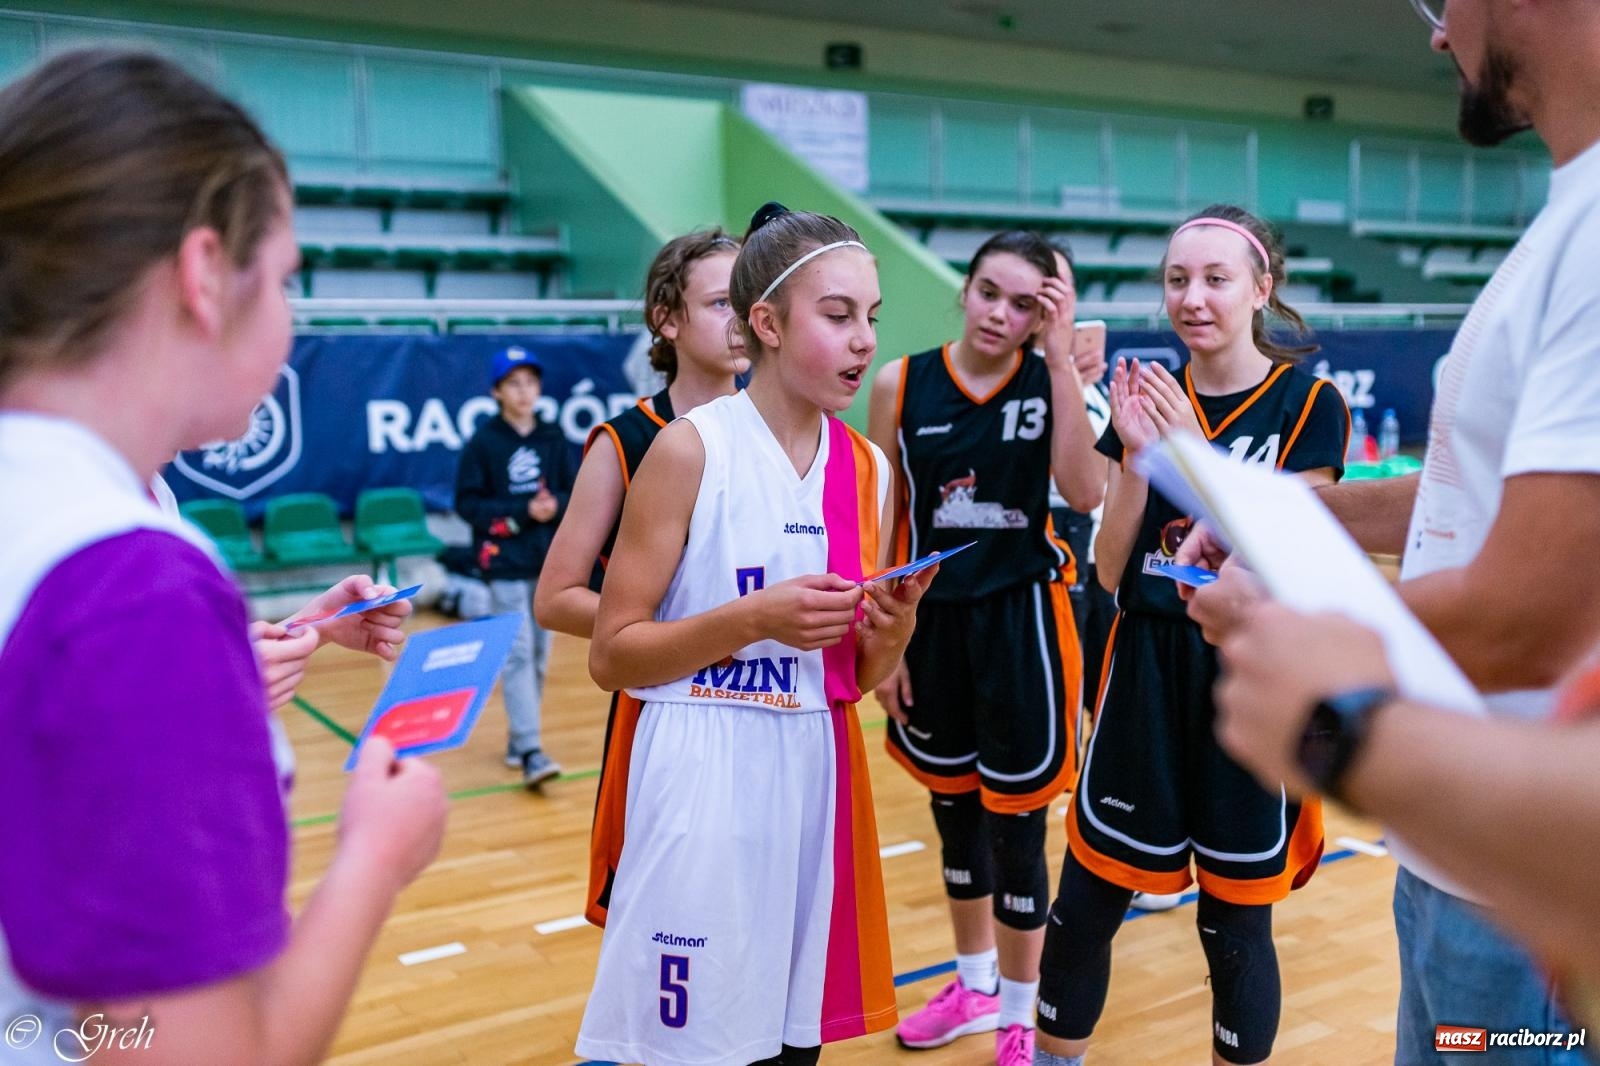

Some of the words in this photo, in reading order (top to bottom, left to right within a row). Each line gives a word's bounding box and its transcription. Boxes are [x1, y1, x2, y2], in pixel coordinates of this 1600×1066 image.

[1001, 397, 1048, 441] 13
[1229, 434, 1281, 472] 14
[689, 684, 801, 709] BASKETBALL
[652, 931, 706, 948] stelman
[660, 953, 690, 1030] 5
[1219, 1028, 1239, 1048] NBA
